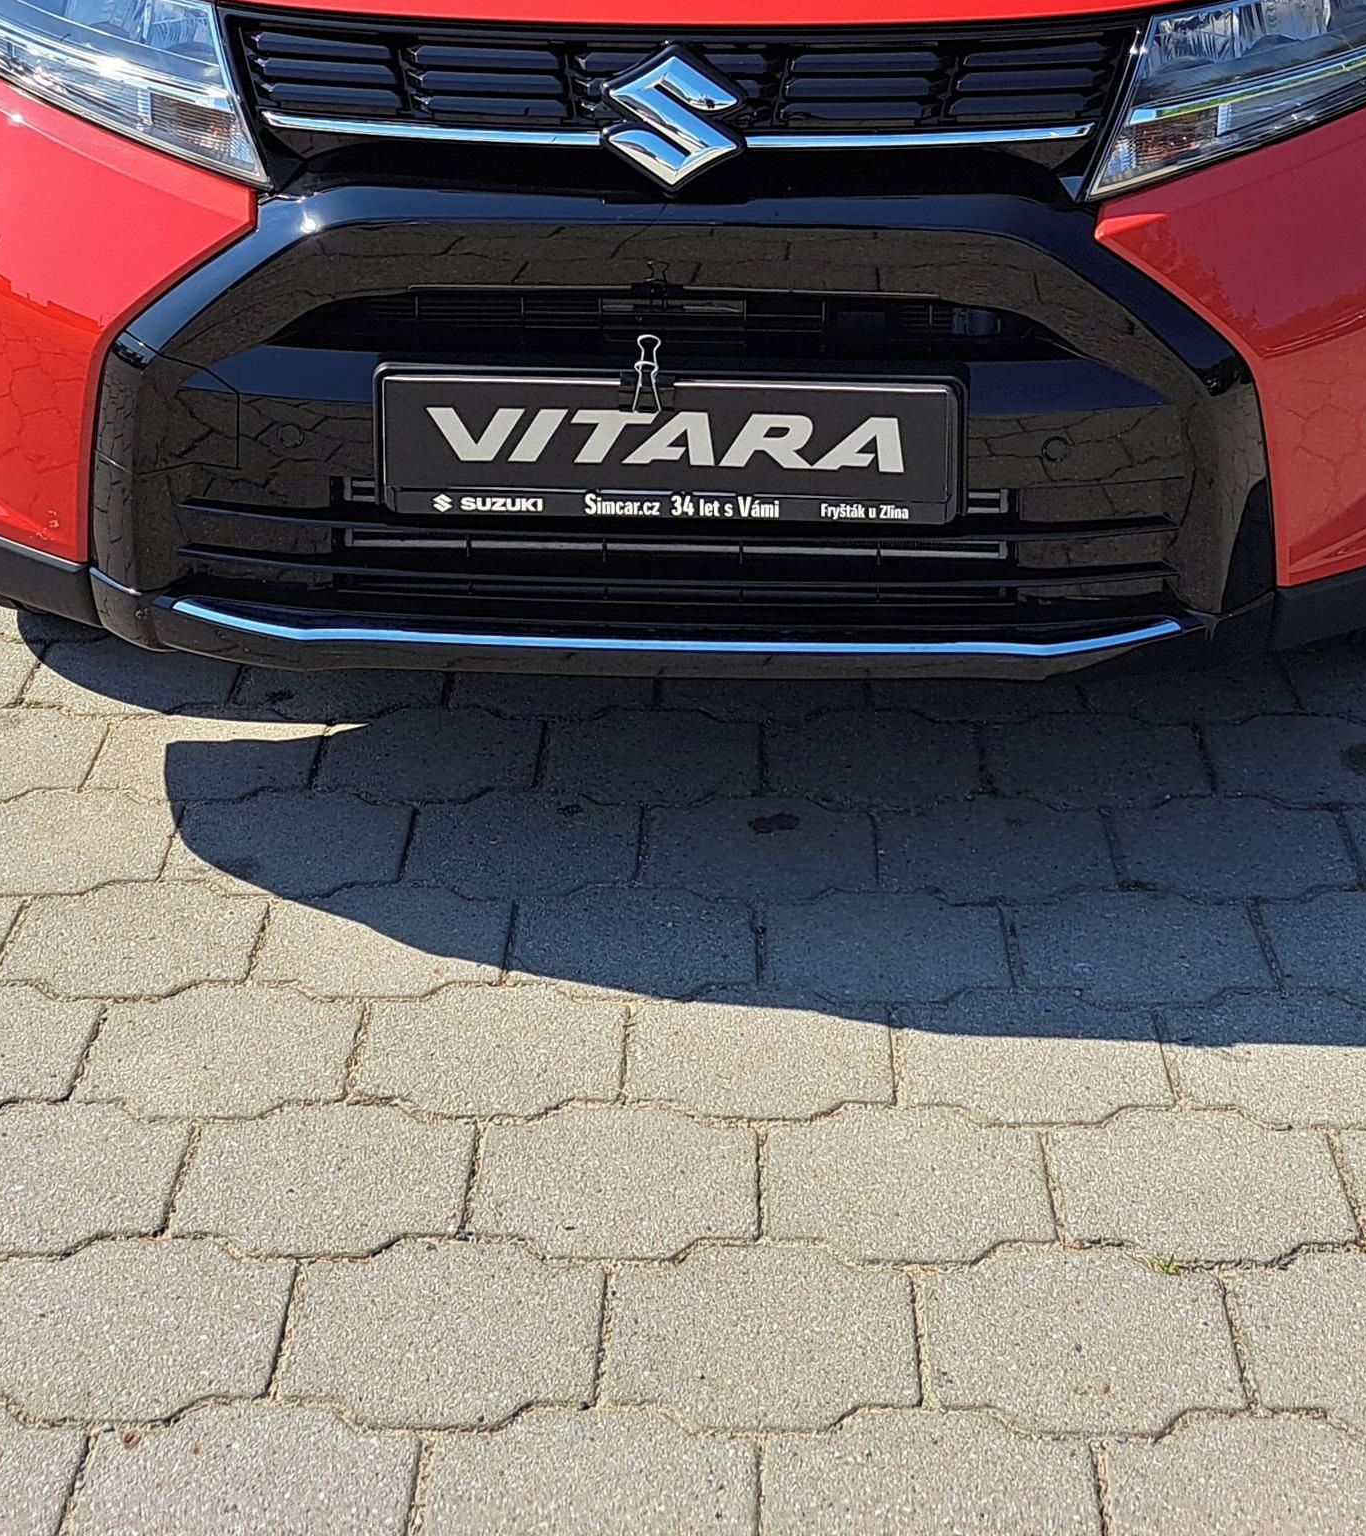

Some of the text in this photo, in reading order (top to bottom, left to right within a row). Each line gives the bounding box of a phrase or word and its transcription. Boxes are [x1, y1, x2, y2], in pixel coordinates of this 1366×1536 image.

[426, 406, 905, 473] VITARA
[459, 496, 544, 512] SUZUKI
[584, 492, 780, 518] Simcar.cz 34 let s Vámi
[819, 502, 866, 520] Fryšták
[868, 506, 877, 519] u
